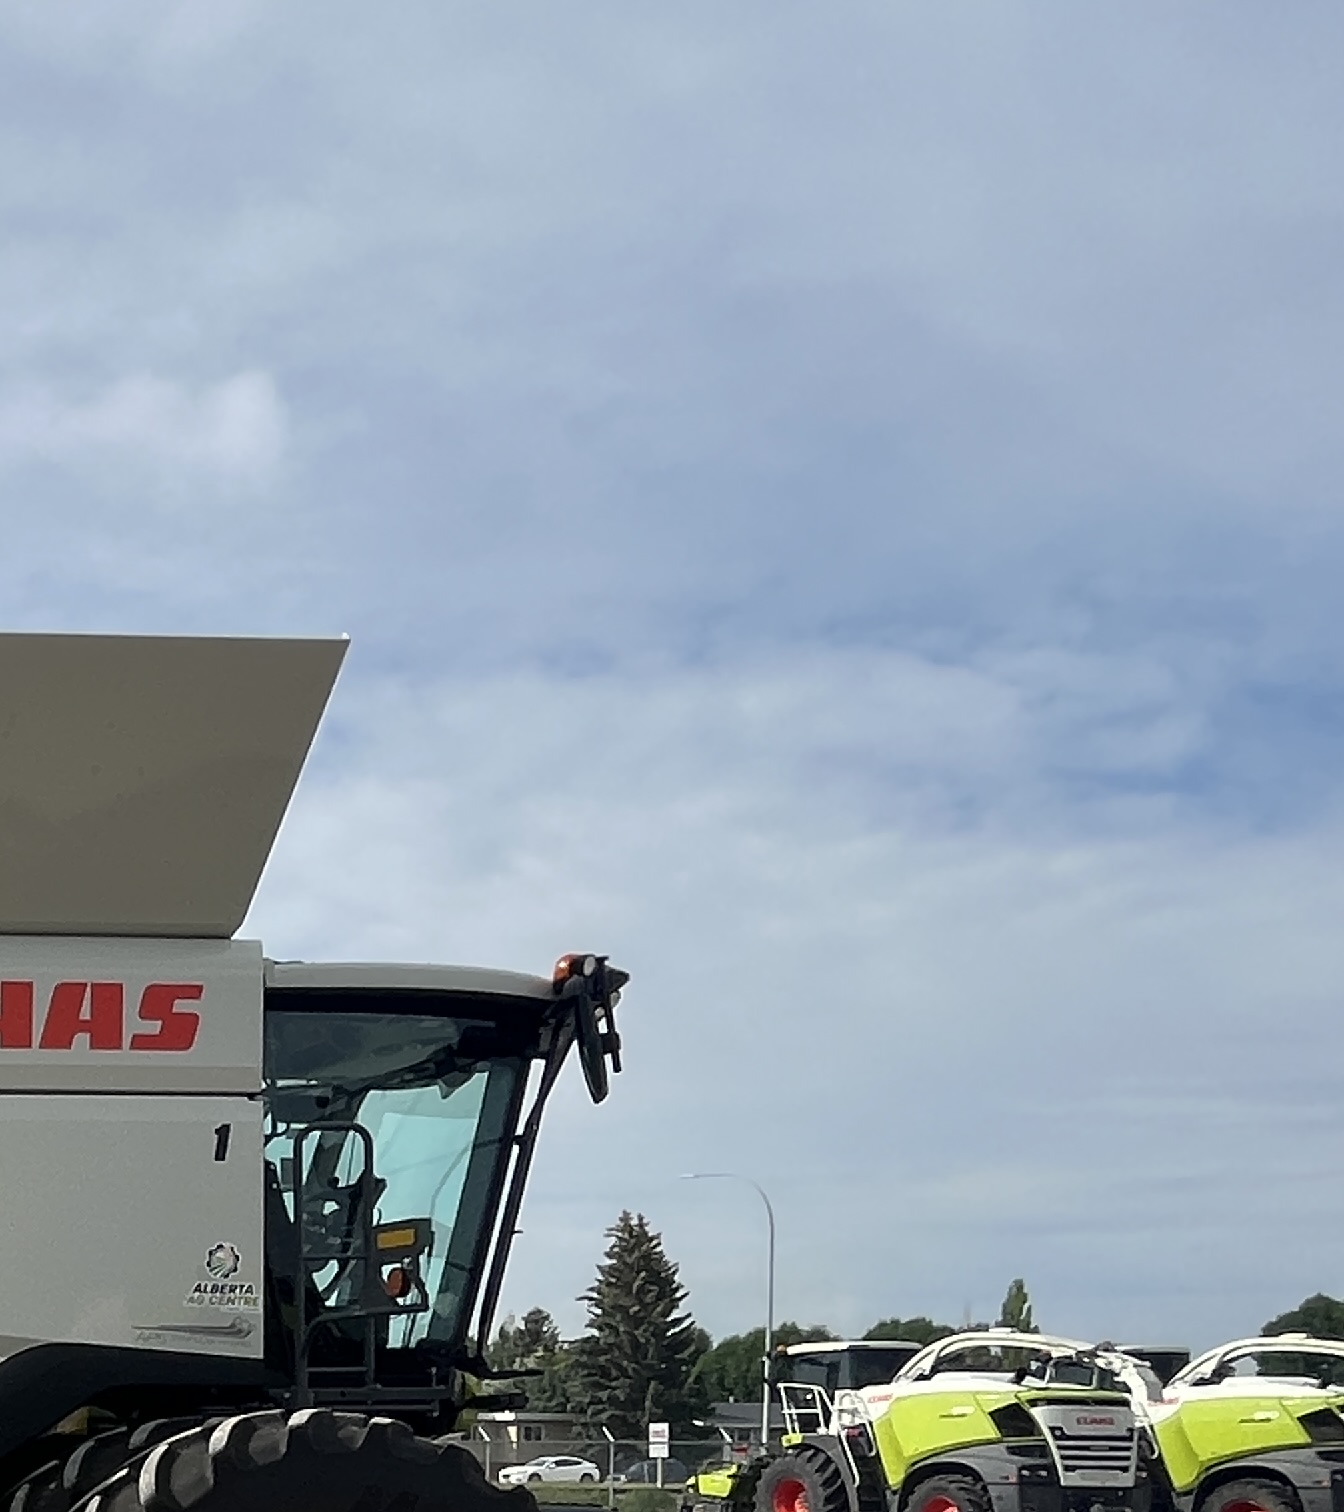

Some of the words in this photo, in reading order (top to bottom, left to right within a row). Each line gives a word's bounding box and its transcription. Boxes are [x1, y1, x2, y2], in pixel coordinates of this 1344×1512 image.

[213, 1122, 231, 1162] 1
[192, 1282, 254, 1295] ALBERTA
[208, 1296, 259, 1307] CENTRE
